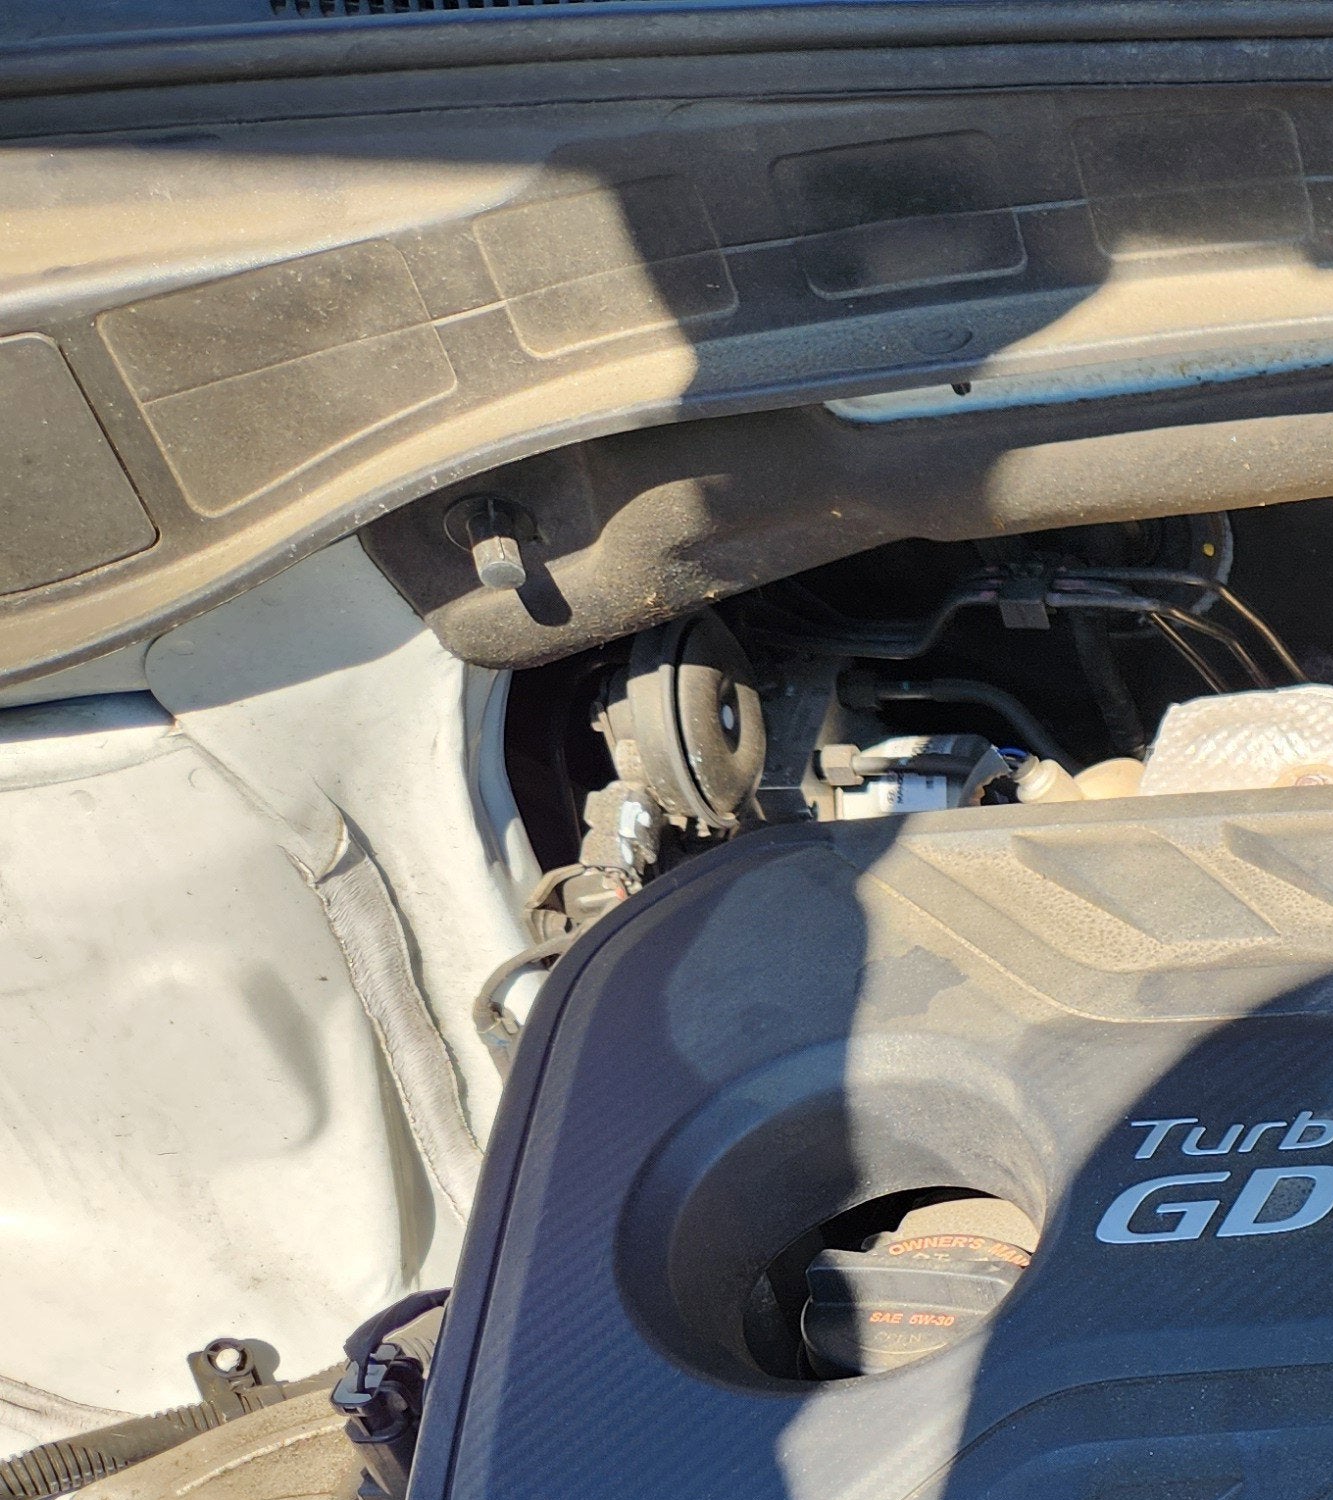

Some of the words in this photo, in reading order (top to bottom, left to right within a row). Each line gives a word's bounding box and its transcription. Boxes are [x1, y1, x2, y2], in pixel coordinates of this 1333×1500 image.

[888, 1235, 986, 1257] OWNER'S
[987, 1242, 1031, 1268] MAN
[869, 1311, 904, 1325] SAE
[908, 1312, 955, 1327] 5W-30
